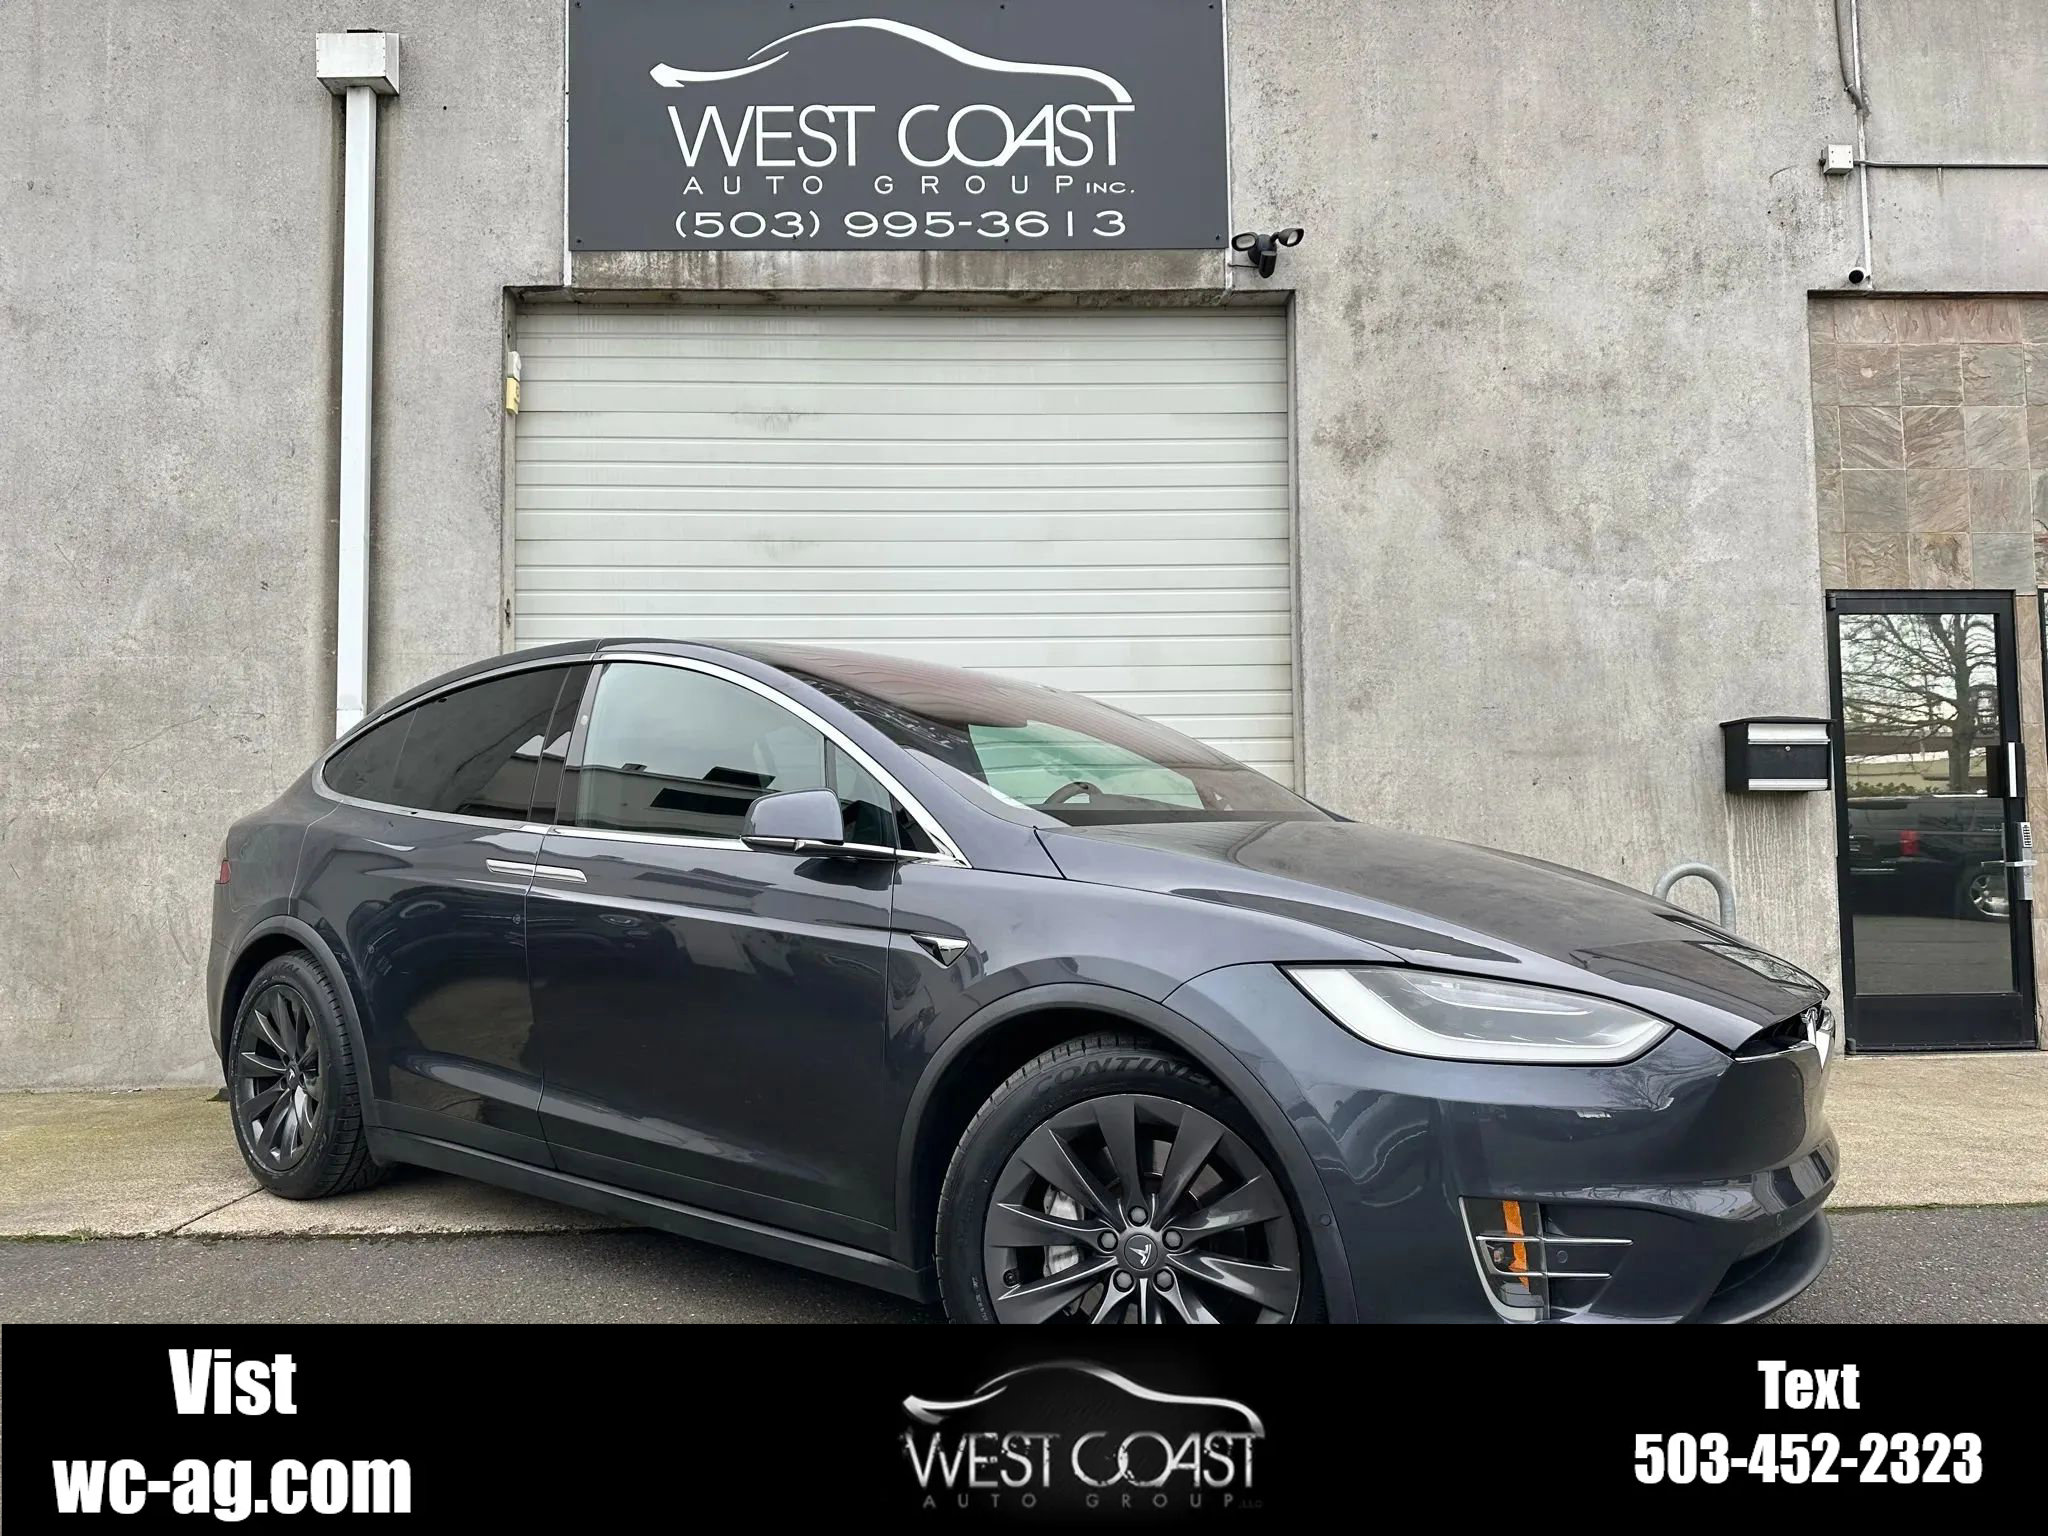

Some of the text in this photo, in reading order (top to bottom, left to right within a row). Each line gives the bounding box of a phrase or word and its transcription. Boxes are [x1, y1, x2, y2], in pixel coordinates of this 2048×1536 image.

[667, 103, 1136, 168] WEST COAST
[682, 175, 1136, 195] AUTO GROUP INC.
[675, 210, 1127, 239] (503) 995-3613
